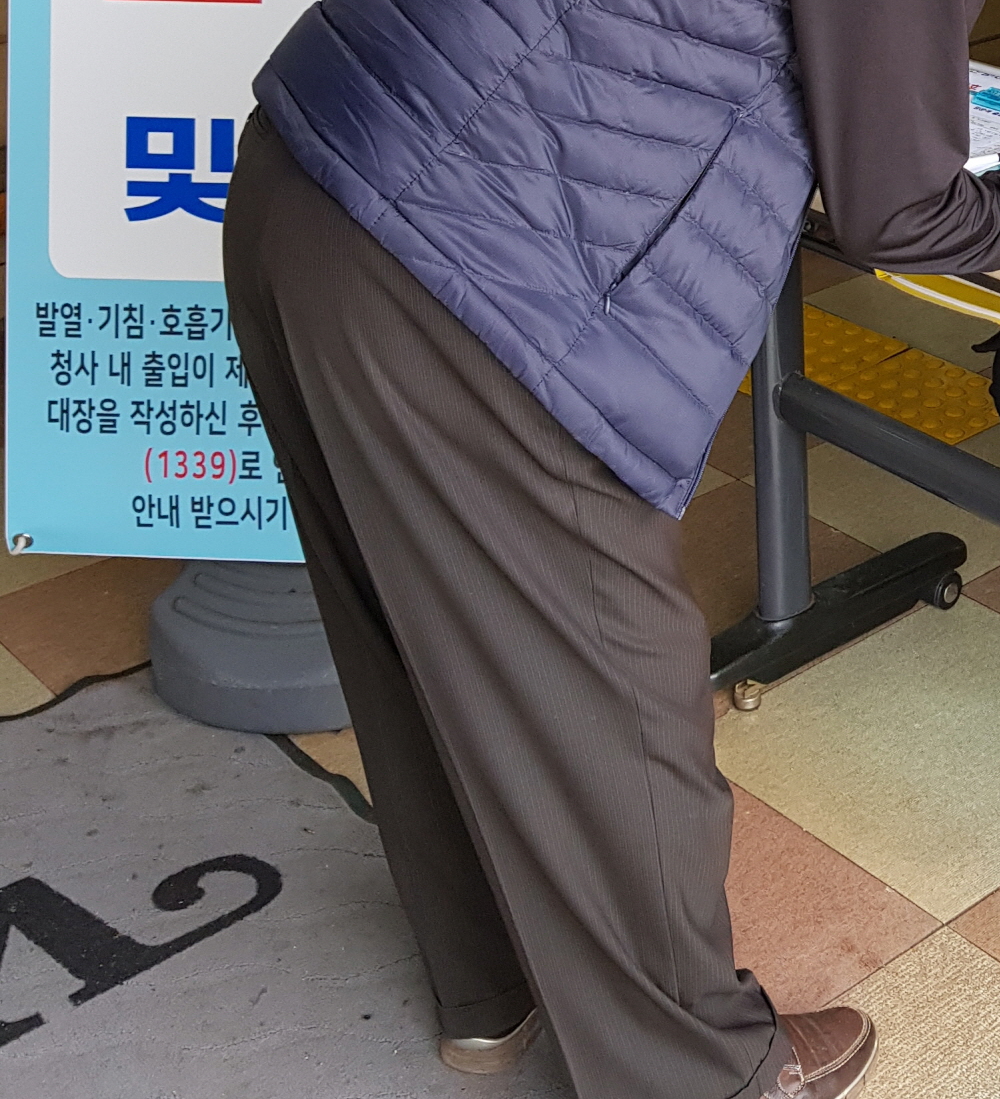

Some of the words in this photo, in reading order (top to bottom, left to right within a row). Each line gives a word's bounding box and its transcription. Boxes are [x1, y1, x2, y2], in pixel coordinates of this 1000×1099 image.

[123, 116, 235, 224] 및
[50, 349, 99, 386] 청사
[109, 351, 131, 387] 내
[142, 351, 215, 388] 출입이
[47, 397, 121, 434] 대장을
[130, 399, 227, 436] 작성하신
[238, 402, 263, 437] 후
[144, 447, 263, 485] (1339)로
[132, 494, 180, 529] 안내
[190, 495, 288, 531] 받으시기
